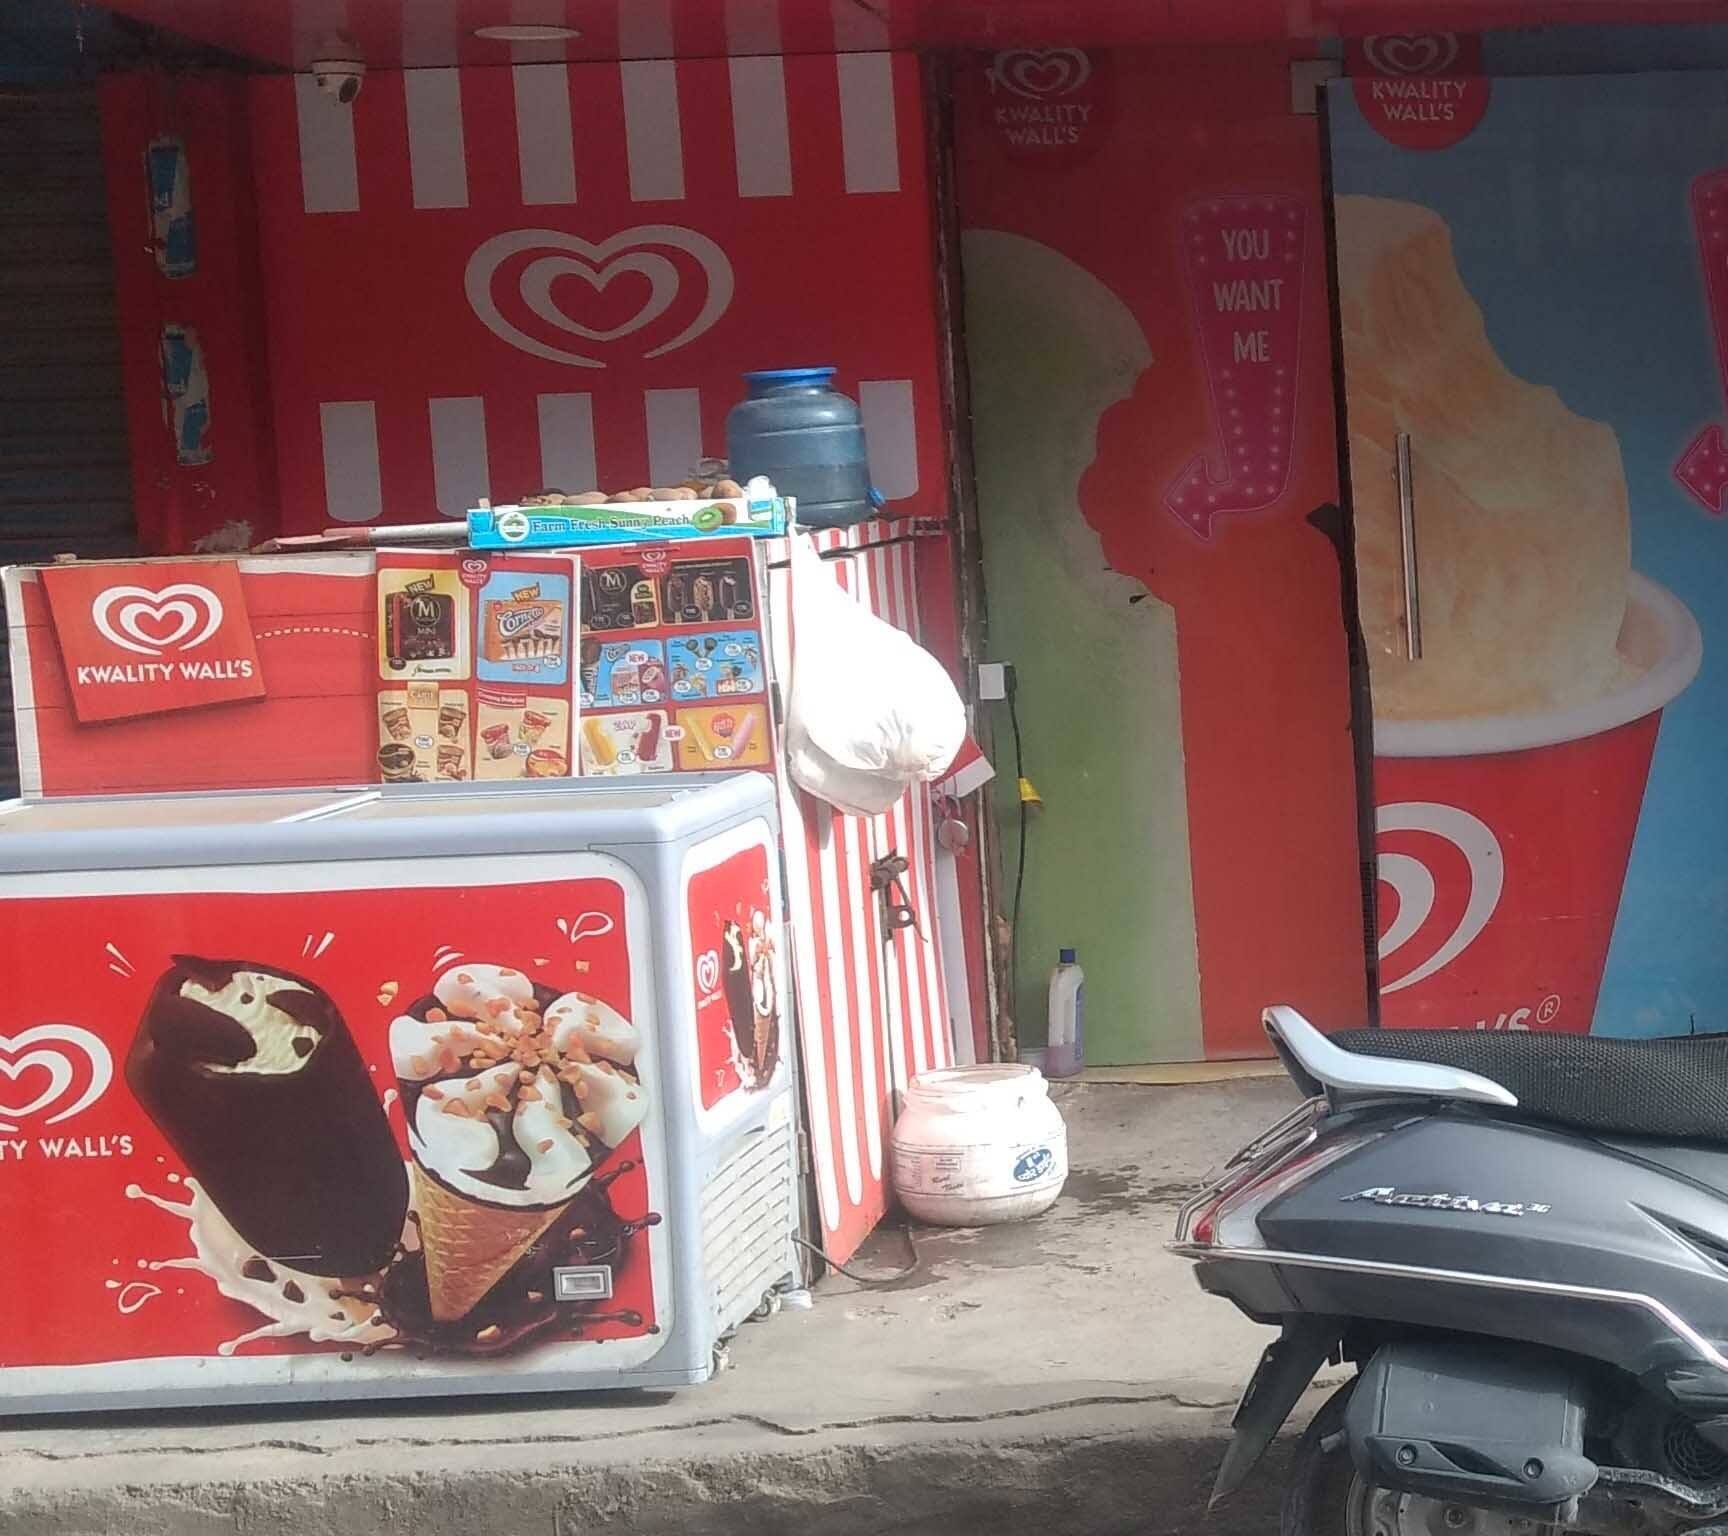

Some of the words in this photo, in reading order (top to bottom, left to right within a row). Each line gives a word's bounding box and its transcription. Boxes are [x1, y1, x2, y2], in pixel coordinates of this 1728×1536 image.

[1372, 81, 1467, 100] KWALITY
[996, 103, 1092, 125] KWALITY
[1383, 103, 1455, 121] WALL'S
[1005, 127, 1080, 145] WALL'S
[1221, 229, 1270, 261] YOU
[1213, 278, 1284, 312] WANT
[1233, 331, 1271, 364] ME
[533, 521, 566, 532] Farm
[653, 514, 690, 526] Peach
[408, 580, 434, 595] NEW
[514, 587, 540, 601] NEW
[77, 663, 174, 685] KWALITY
[179, 659, 254, 680] WALL'S
[39, 1134, 134, 1158] WALL'S
